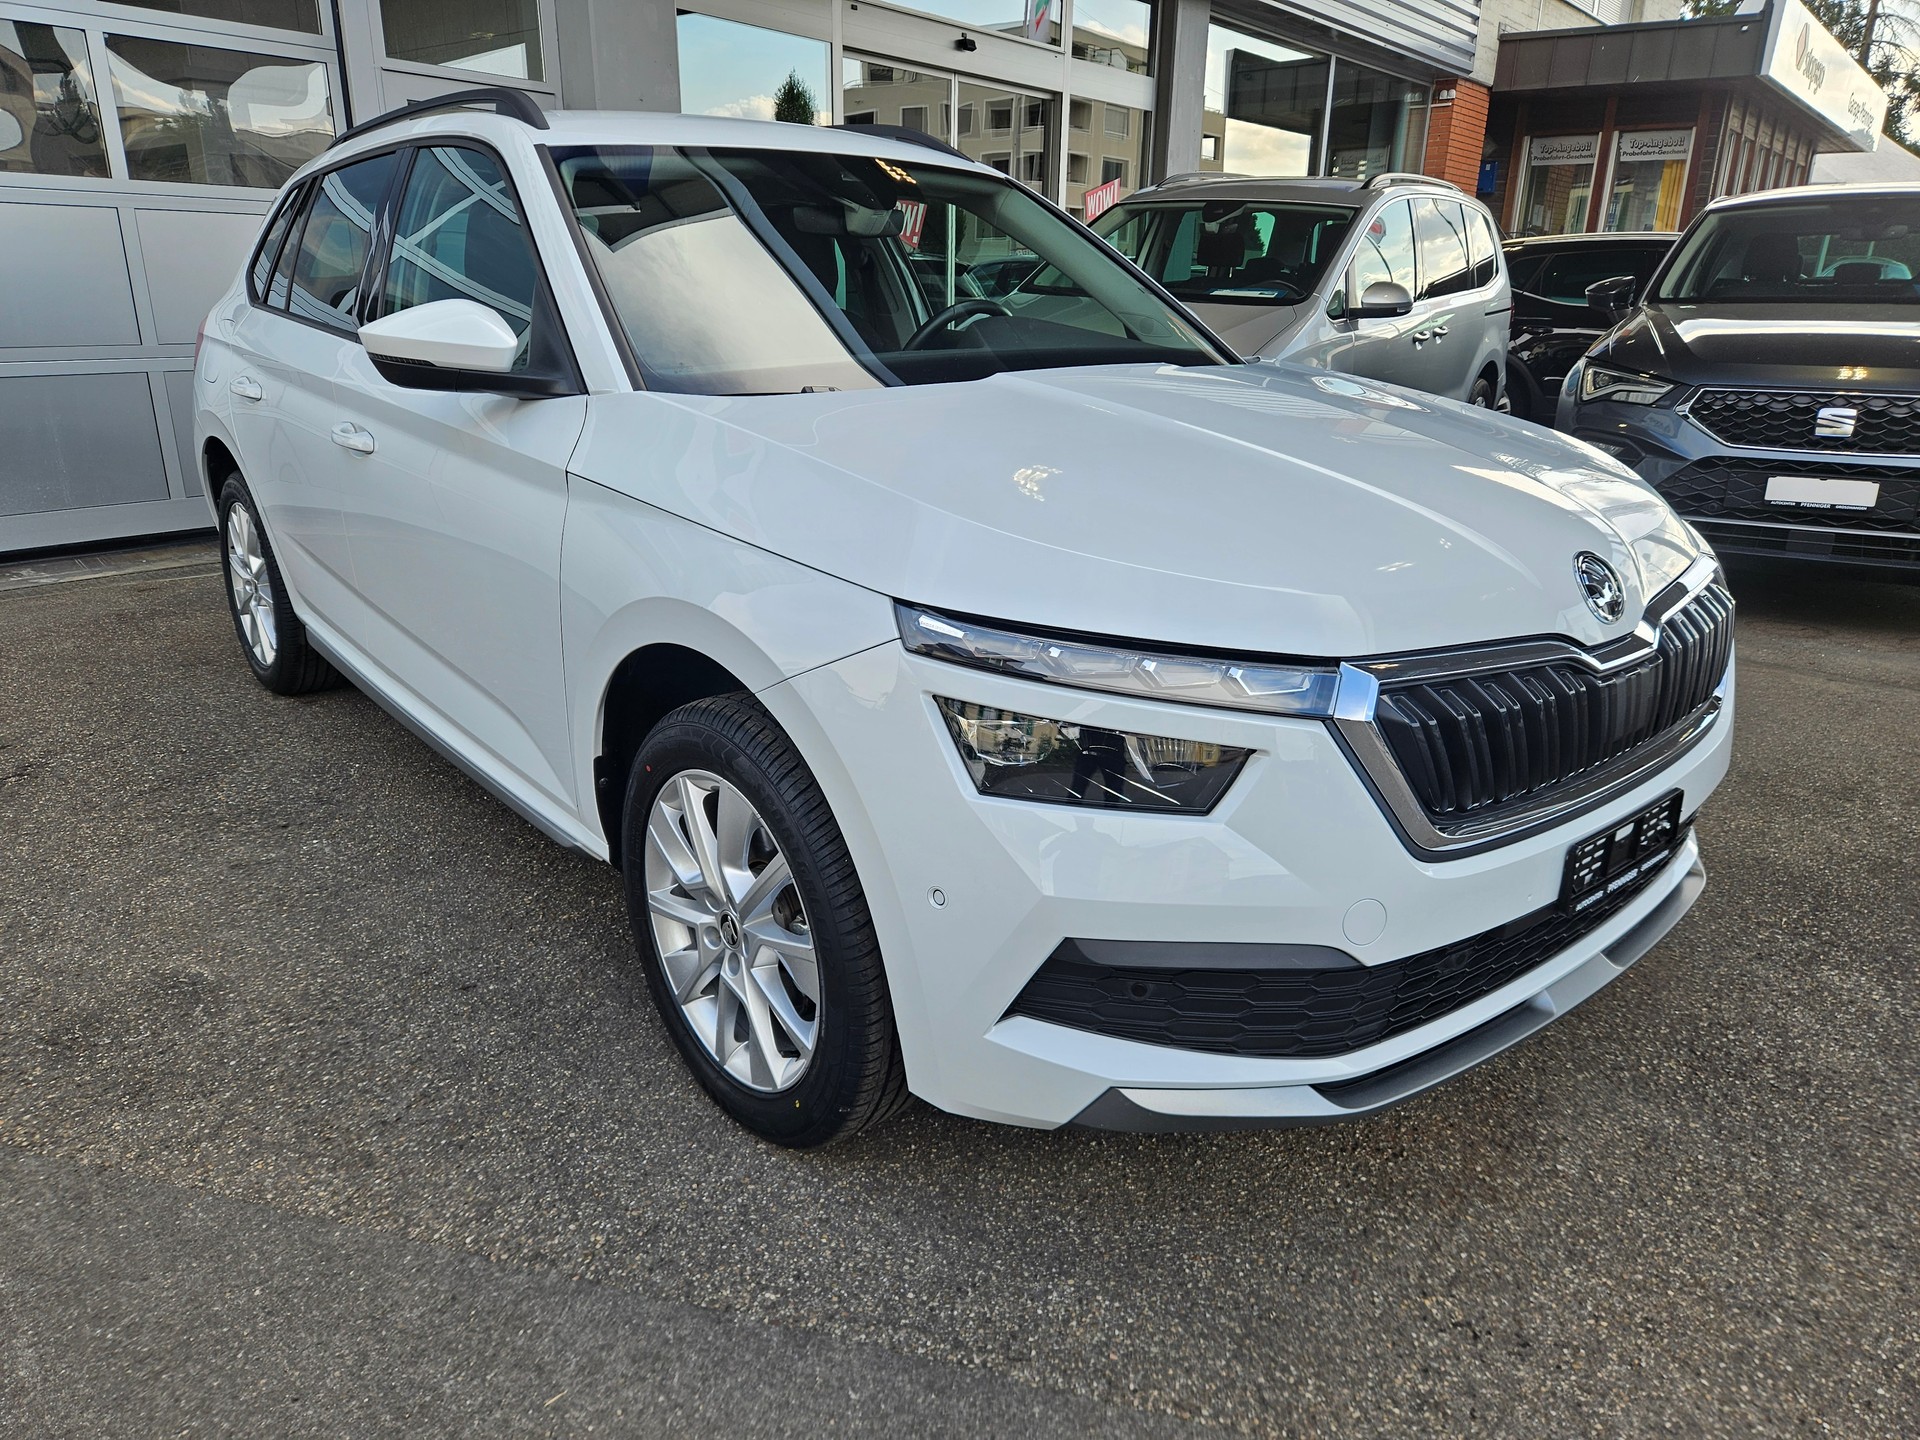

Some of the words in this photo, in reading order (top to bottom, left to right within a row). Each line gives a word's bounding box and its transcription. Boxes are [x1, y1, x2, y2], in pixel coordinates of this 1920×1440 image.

[1540, 141, 1592, 154] Top-Angebot!
[1630, 136, 1686, 149] Top-Angebot!
[1087, 178, 1120, 217] WOW!
